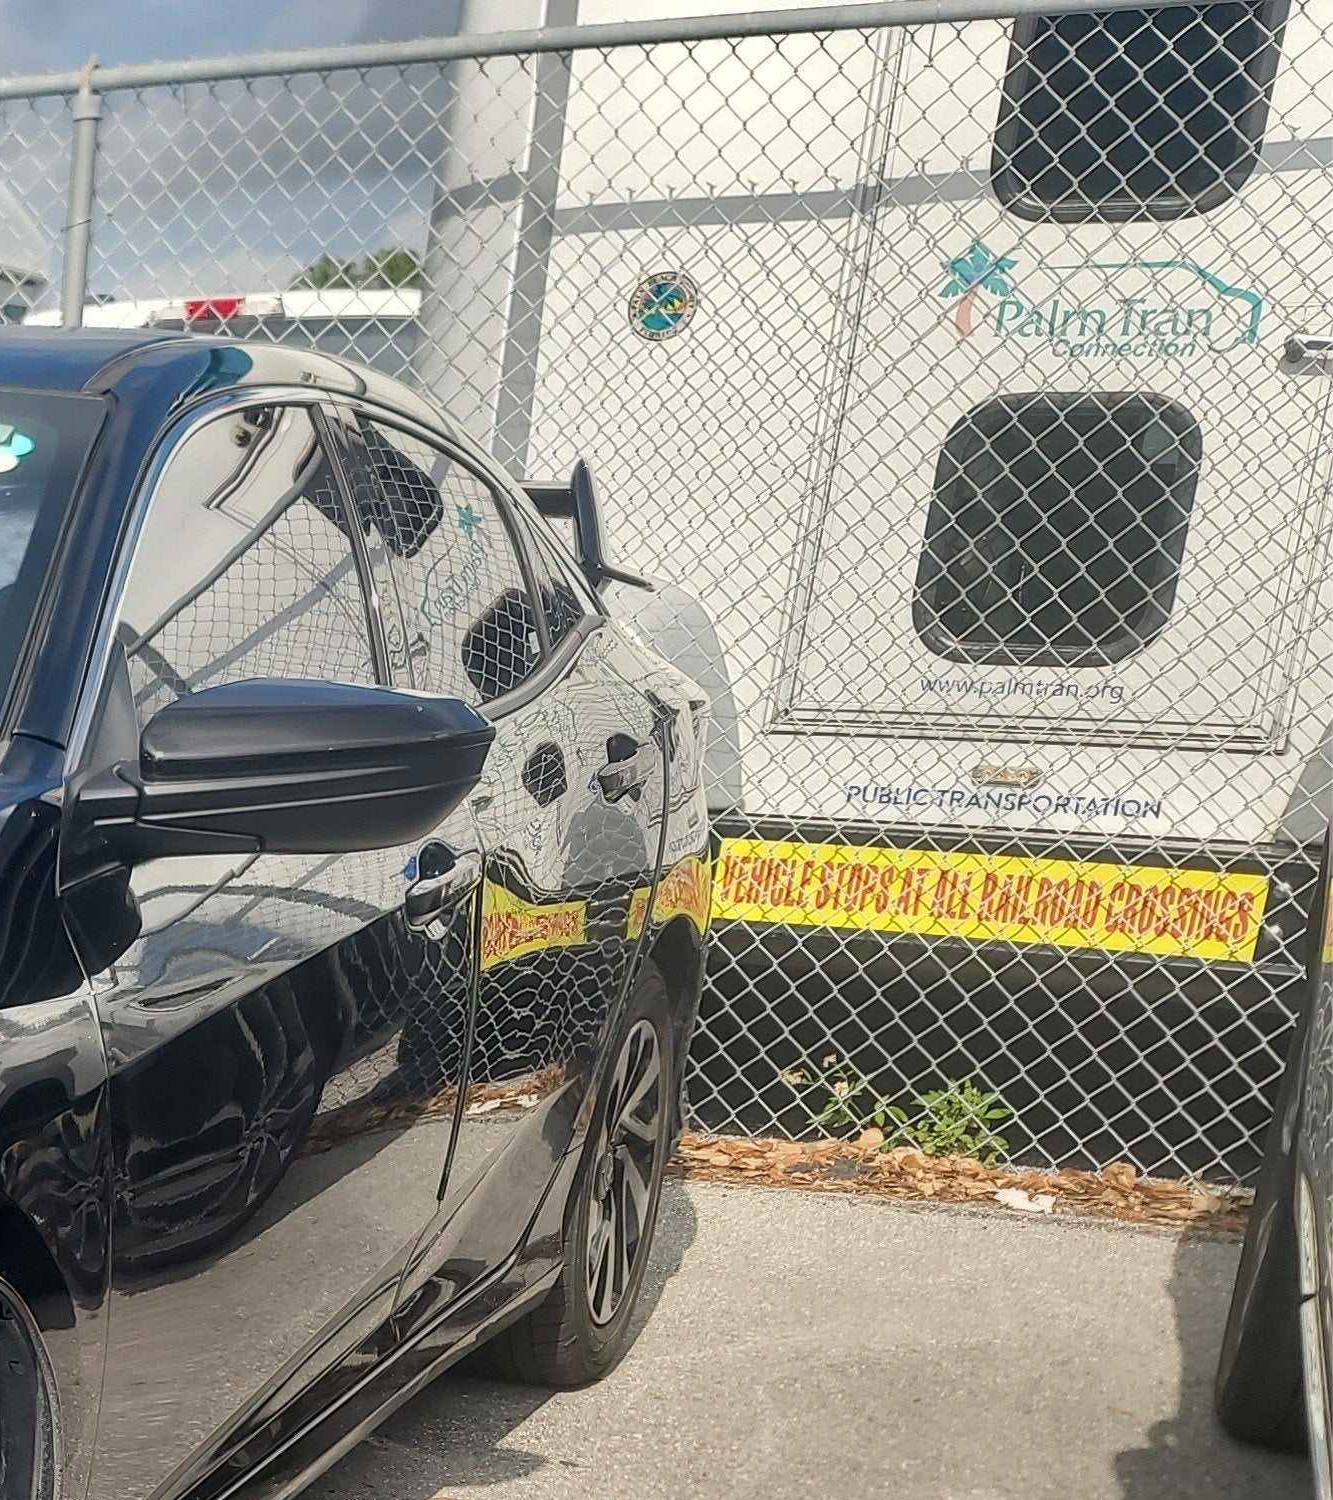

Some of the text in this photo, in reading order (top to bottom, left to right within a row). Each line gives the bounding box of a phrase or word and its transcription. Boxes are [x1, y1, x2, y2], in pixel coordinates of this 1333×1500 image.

[992, 297, 1213, 338] Palm Tran
[1052, 337, 1196, 358] Connection
[920, 677, 1124, 704] www.palmtran.org
[846, 785, 1163, 820] PUBLIC TRANSPORTATION
[720, 855, 815, 909] VEHICLE
[815, 860, 898, 915] STOPS
[896, 868, 931, 917] AT
[929, 869, 973, 922] ALL
[976, 872, 1102, 931] RAILROAD
[1105, 881, 1256, 945] CROSSINGS
